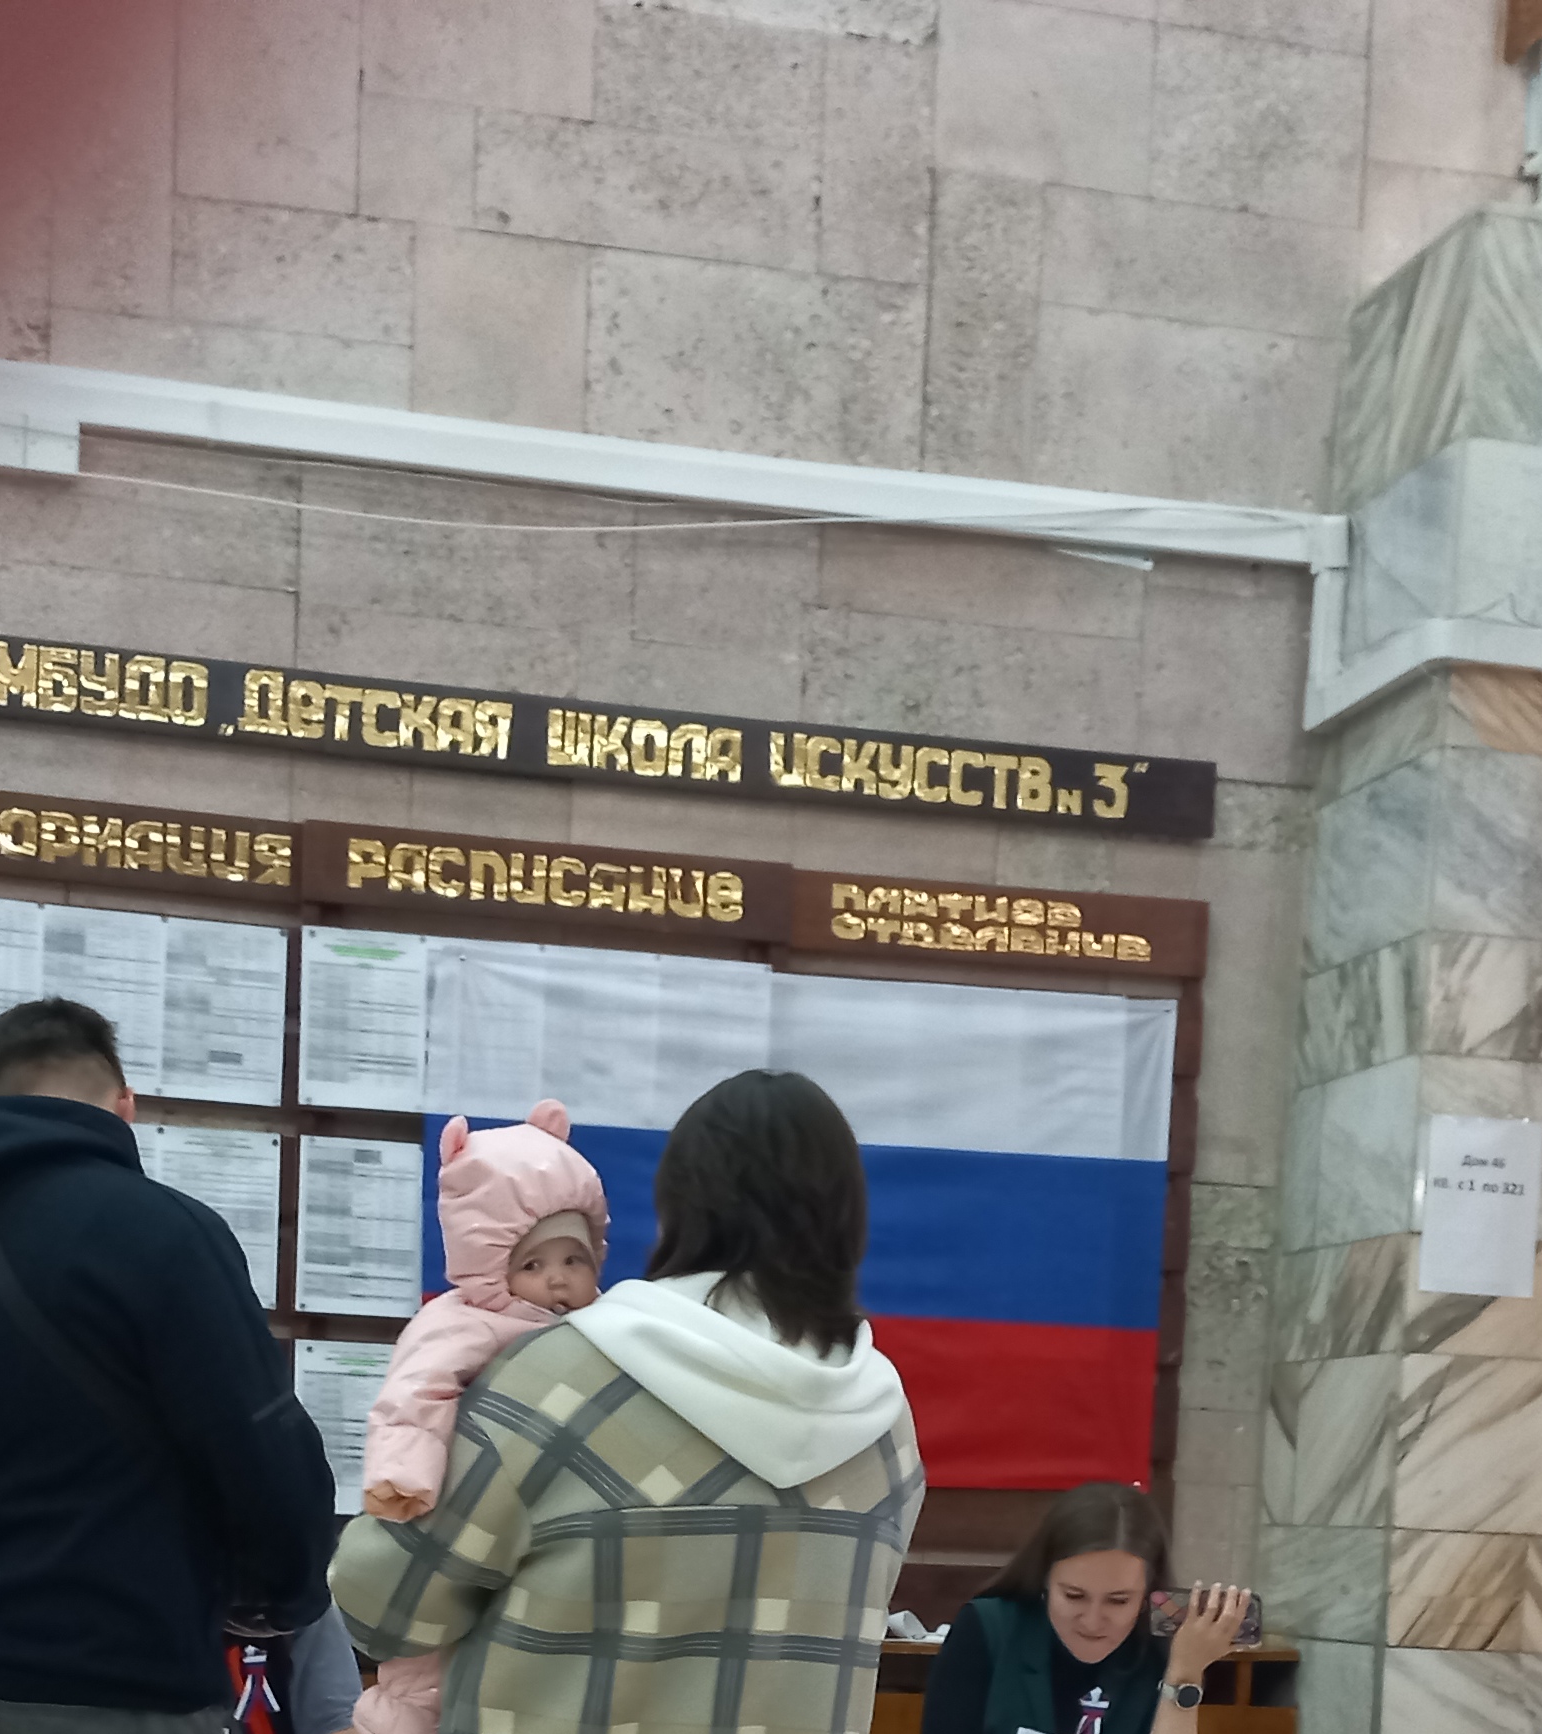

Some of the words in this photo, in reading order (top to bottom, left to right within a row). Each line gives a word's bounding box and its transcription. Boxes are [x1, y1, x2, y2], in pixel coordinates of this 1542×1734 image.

[546, 708, 743, 784] ШКОЛА
[769, 731, 1052, 813] ИСКУССТВ
[346, 837, 744, 923] РАСПИСАНИЕ
